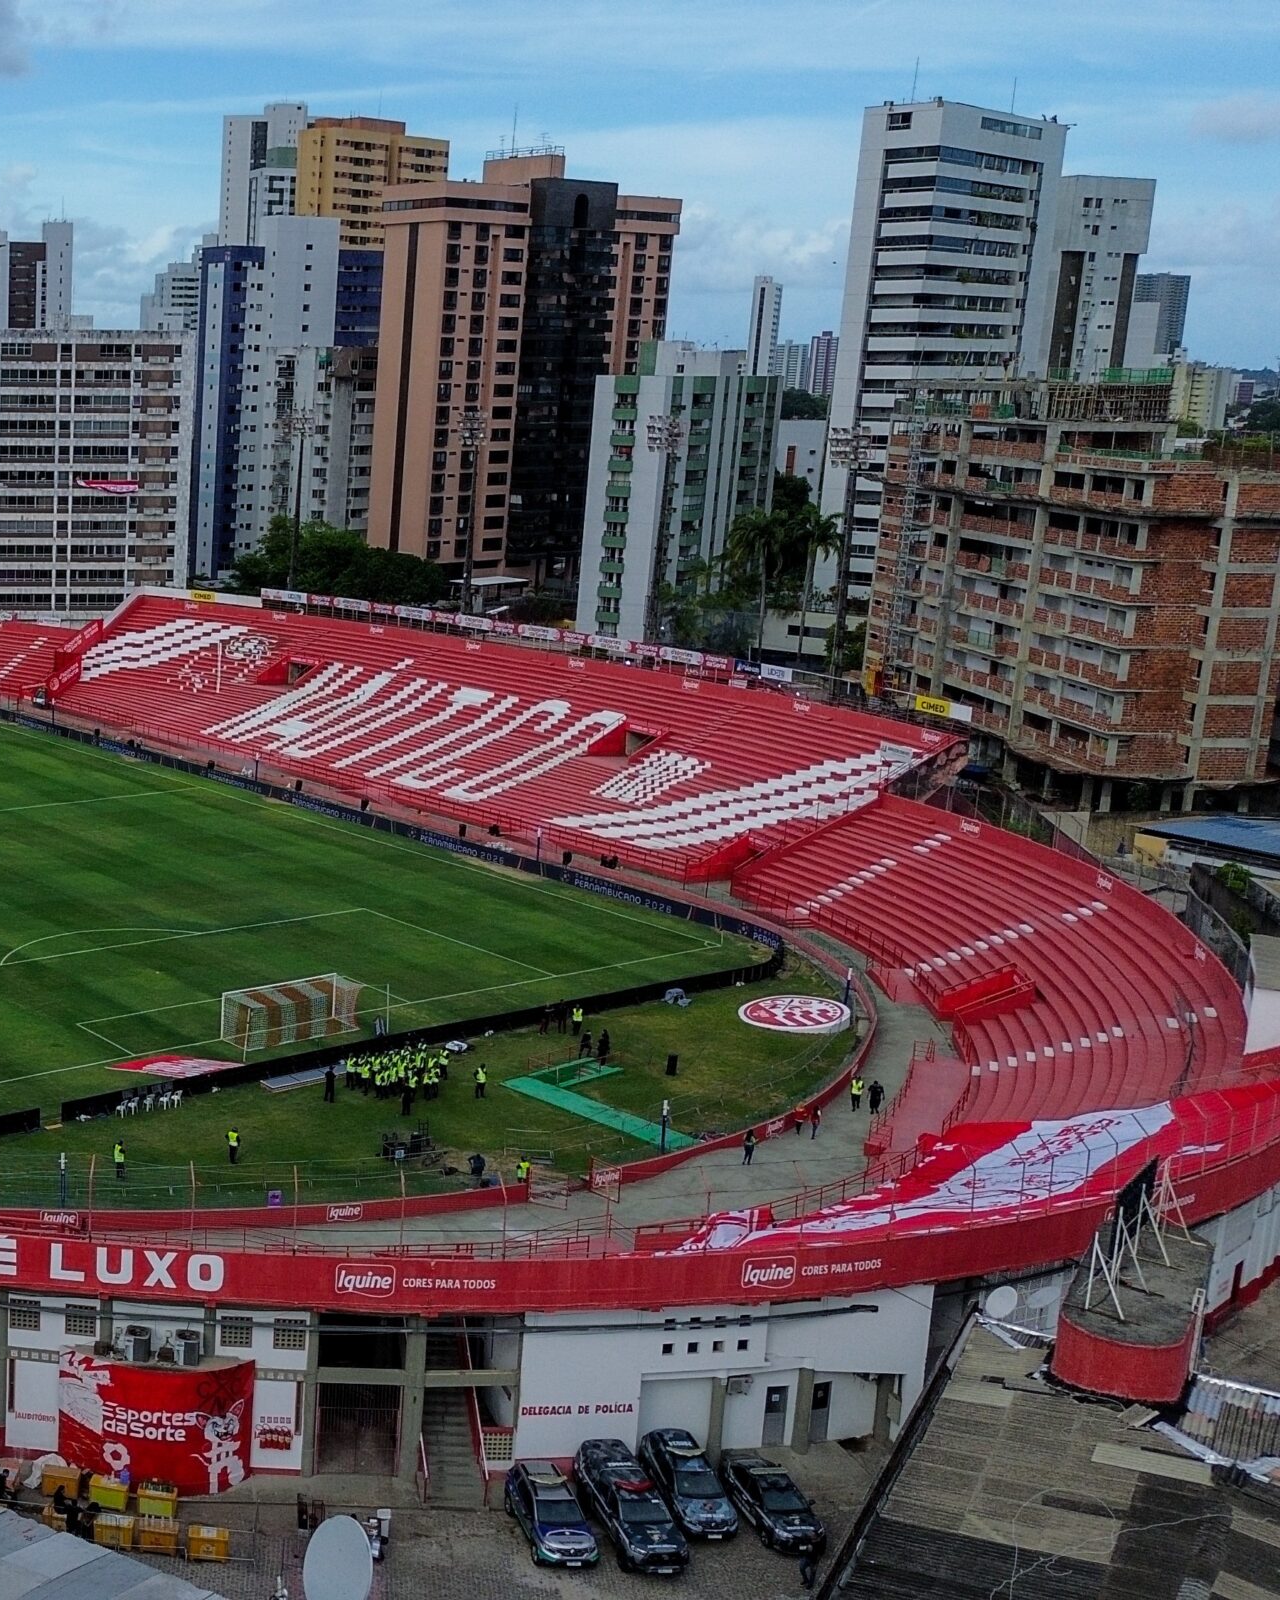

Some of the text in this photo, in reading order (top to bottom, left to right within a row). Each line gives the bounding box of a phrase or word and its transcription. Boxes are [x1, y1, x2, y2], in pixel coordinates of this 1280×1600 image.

[921, 701, 945, 714] CIMED
[420, 834, 504, 865] PERNAMBUCANO 2026
[574, 878, 672, 914] PERNAMBUCANO 2026
[329, 1205, 361, 1220] Iquine
[50, 1242, 224, 1292] LUXO
[744, 1259, 882, 1285] Iquine CORES PARA TODOS
[338, 1270, 496, 1292] Iquine CORES PARA TODOS
[102, 1402, 196, 1426] Esportes
[521, 1402, 633, 1416] DELEGACIA DE POLÍCIA
